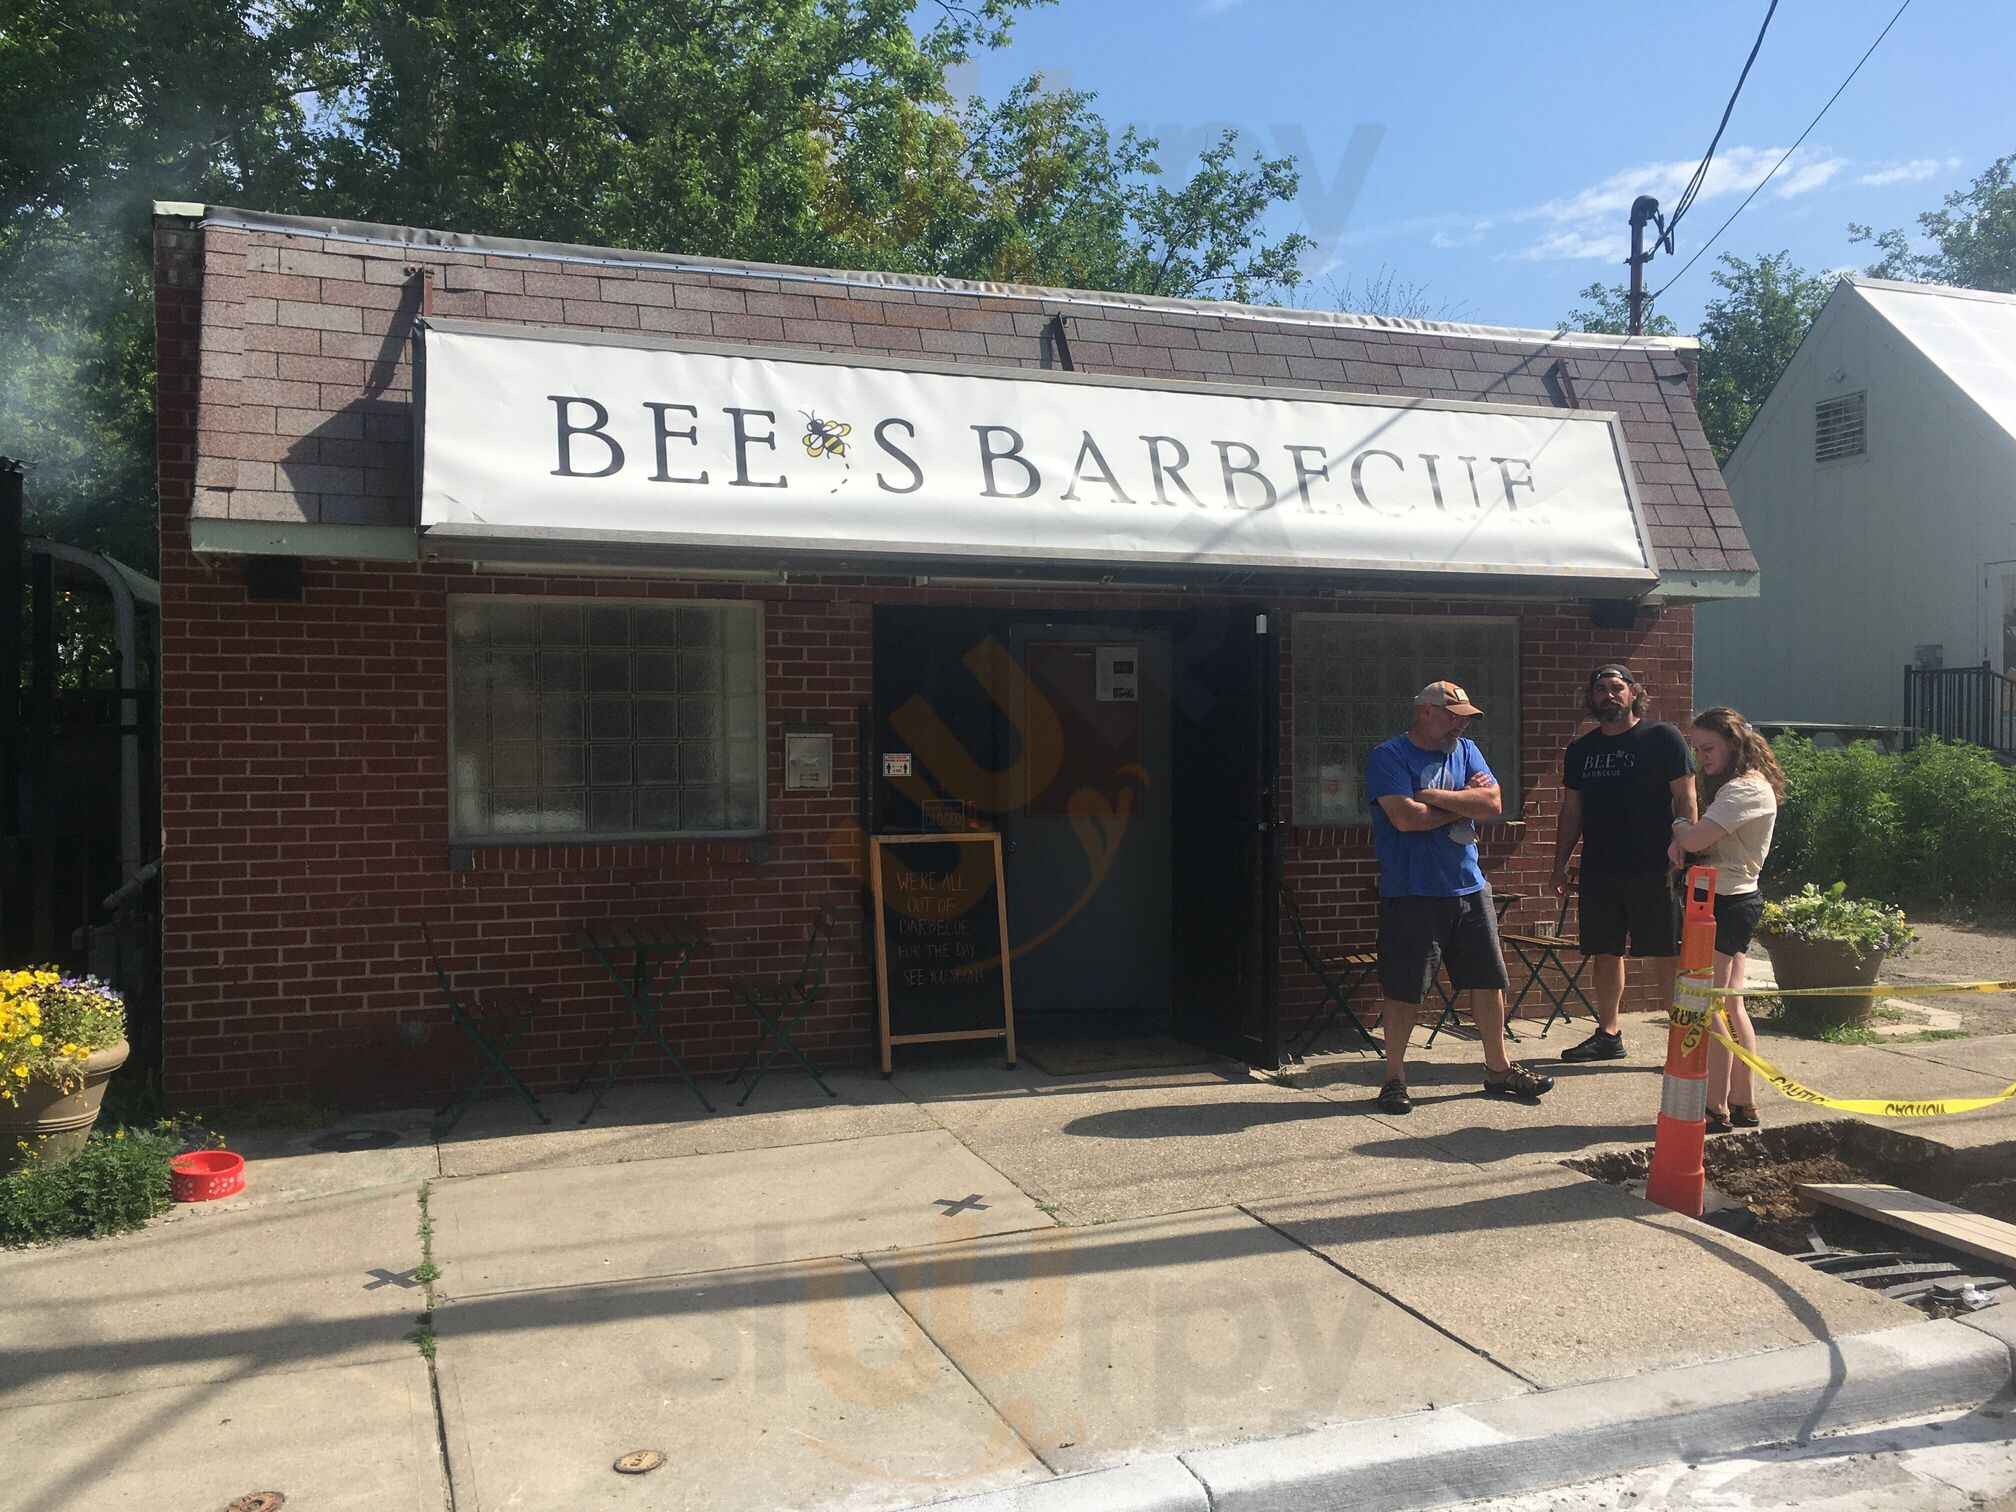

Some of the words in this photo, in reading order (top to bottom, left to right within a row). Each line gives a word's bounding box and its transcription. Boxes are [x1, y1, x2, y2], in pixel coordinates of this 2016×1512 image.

[970, 424, 1552, 525] BARBECUE
[942, 871, 968, 892] ALL
[907, 896, 934, 913] OUT
[937, 897, 956, 913] OF
[899, 918, 970, 937] BARBECUE
[897, 944, 920, 960] FOR
[928, 943, 949, 959] THE
[955, 941, 976, 959] DAY
[903, 968, 923, 986] SEE
[929, 967, 947, 985] YOU
